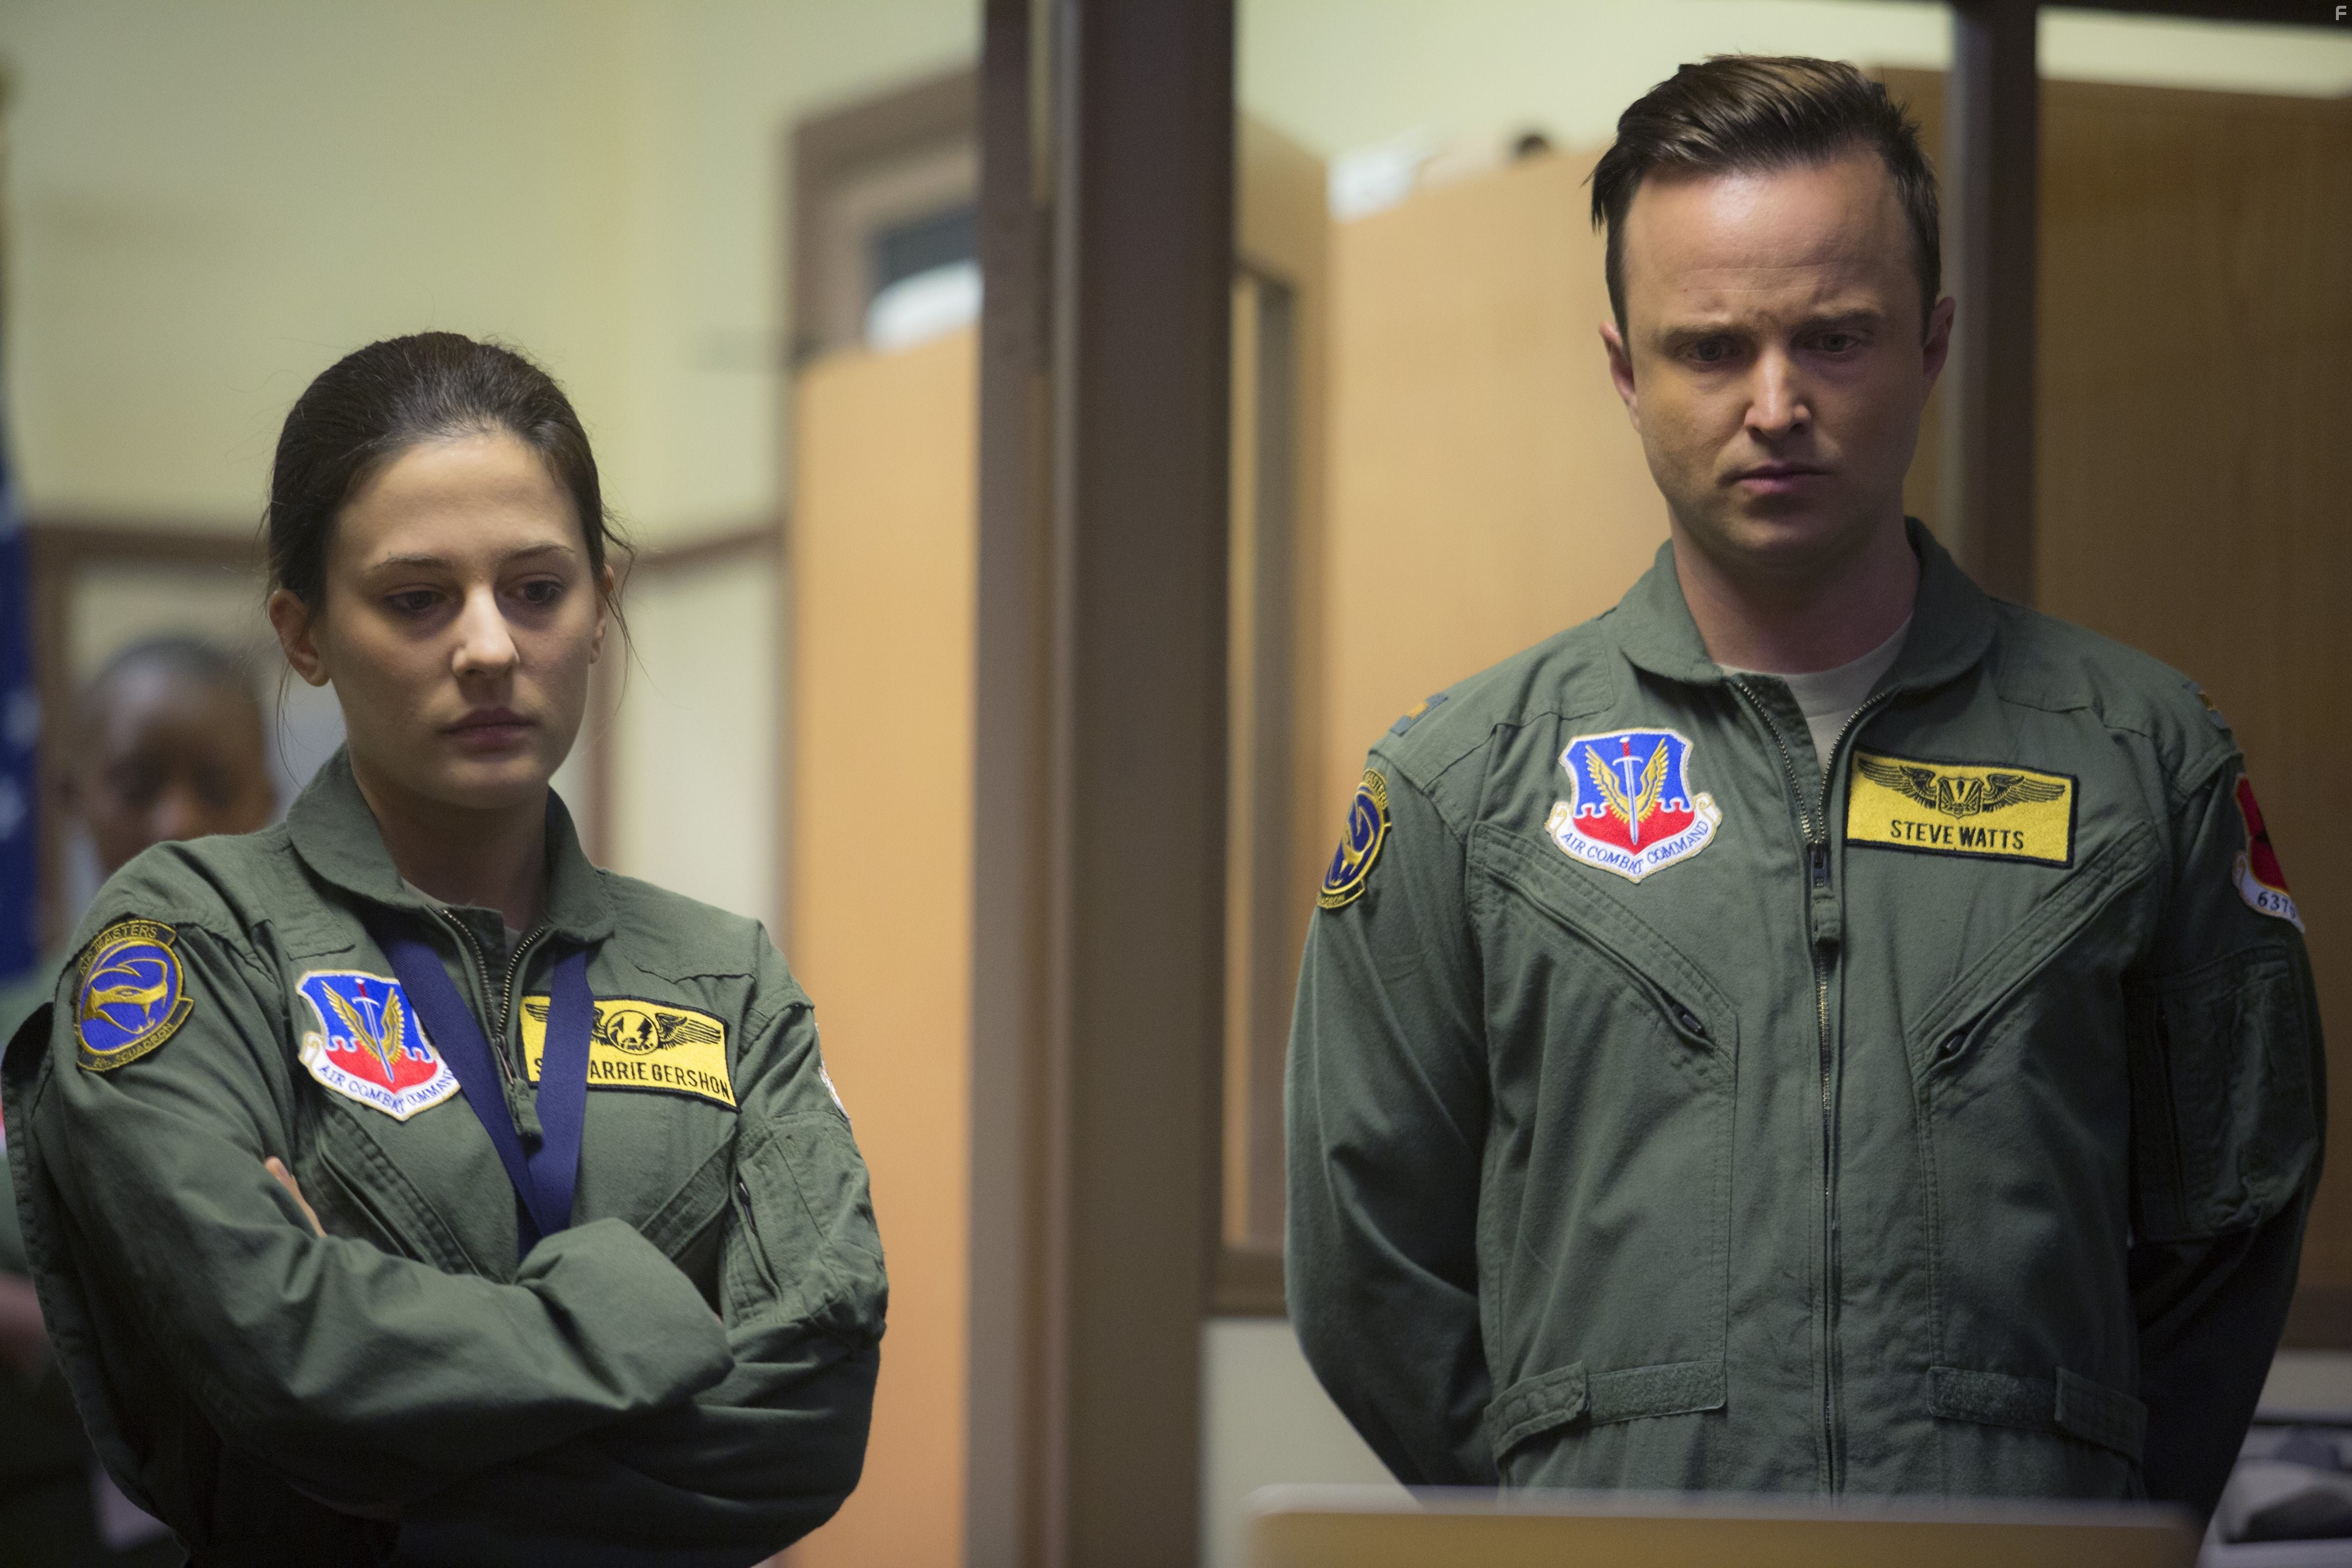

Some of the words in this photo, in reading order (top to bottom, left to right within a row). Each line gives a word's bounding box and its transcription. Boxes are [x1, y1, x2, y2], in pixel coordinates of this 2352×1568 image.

[1562, 832, 1587, 855] AIR
[1587, 845, 1644, 874] COMBAT
[1646, 820, 1709, 864] COMMAND
[1890, 820, 1953, 844] STEVE
[1959, 827, 2025, 850] WATTS
[93, 924, 157, 953] MASTERS
[115, 1023, 175, 1062] SQUADRON
[590, 1060, 649, 1081] ARRIE
[318, 1065, 346, 1087] AIR
[349, 1081, 404, 1113] COMBAT
